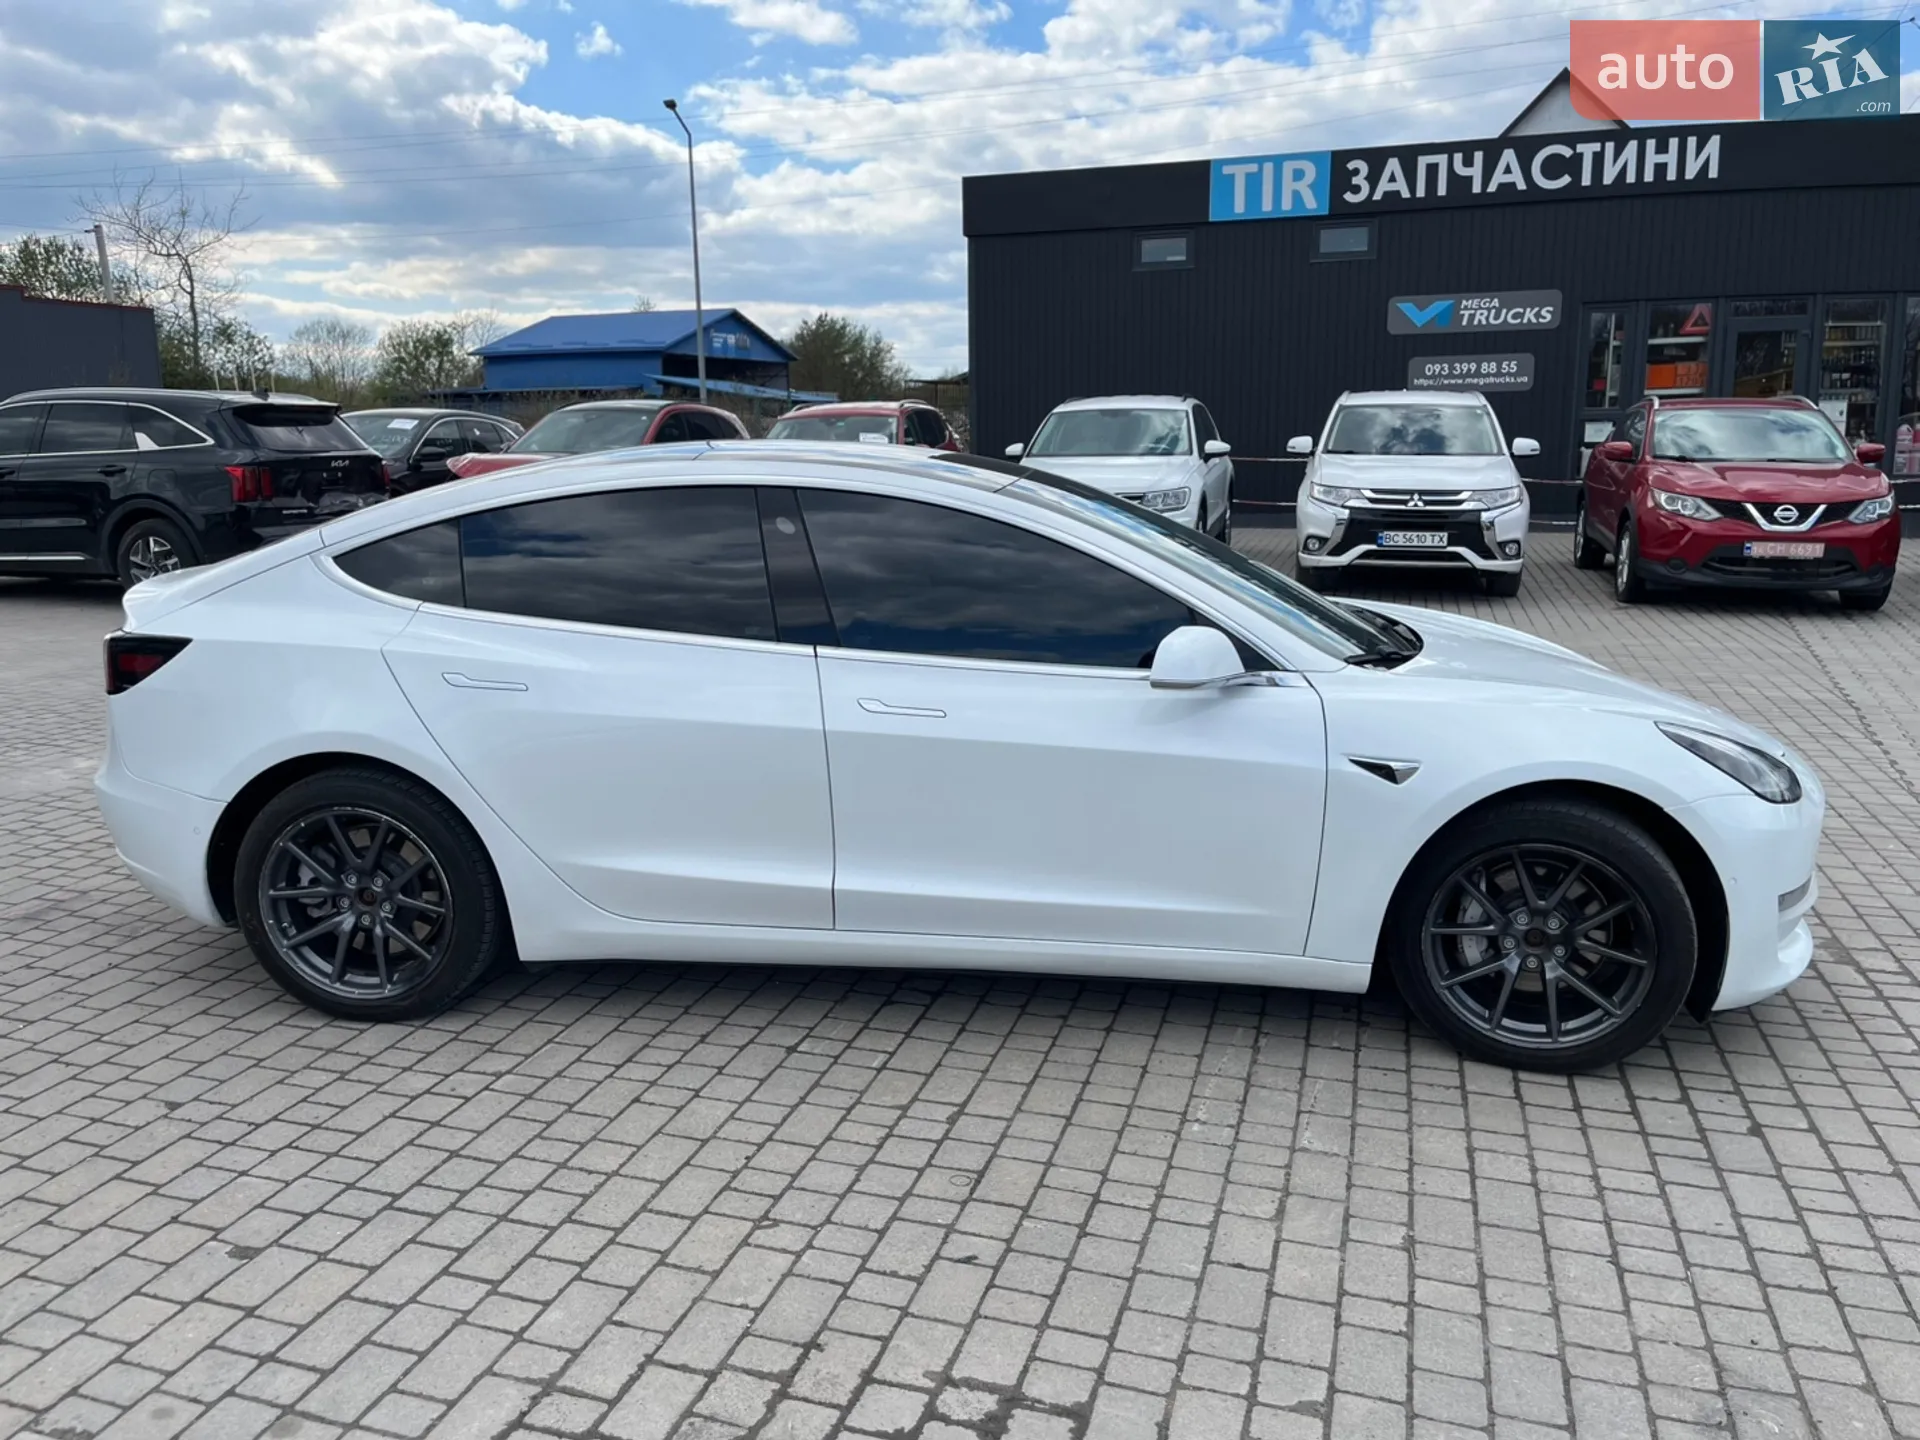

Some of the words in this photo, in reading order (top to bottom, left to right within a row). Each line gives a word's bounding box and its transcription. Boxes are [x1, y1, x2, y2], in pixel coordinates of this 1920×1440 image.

[1221, 159, 1318, 213] TIR
[1342, 134, 1722, 203] ЗАПЧАСТИНИ
[1460, 298, 1500, 309] MEGA
[1459, 306, 1554, 325] TRUCKS
[1425, 363, 1449, 375] 093
[1452, 362, 1477, 374] 399
[1480, 361, 1497, 373] 88
[1501, 361, 1517, 372] 55
[1384, 533, 1400, 544] BC
[1402, 533, 1427, 544] 5610
[1429, 533, 1446, 545] TX
